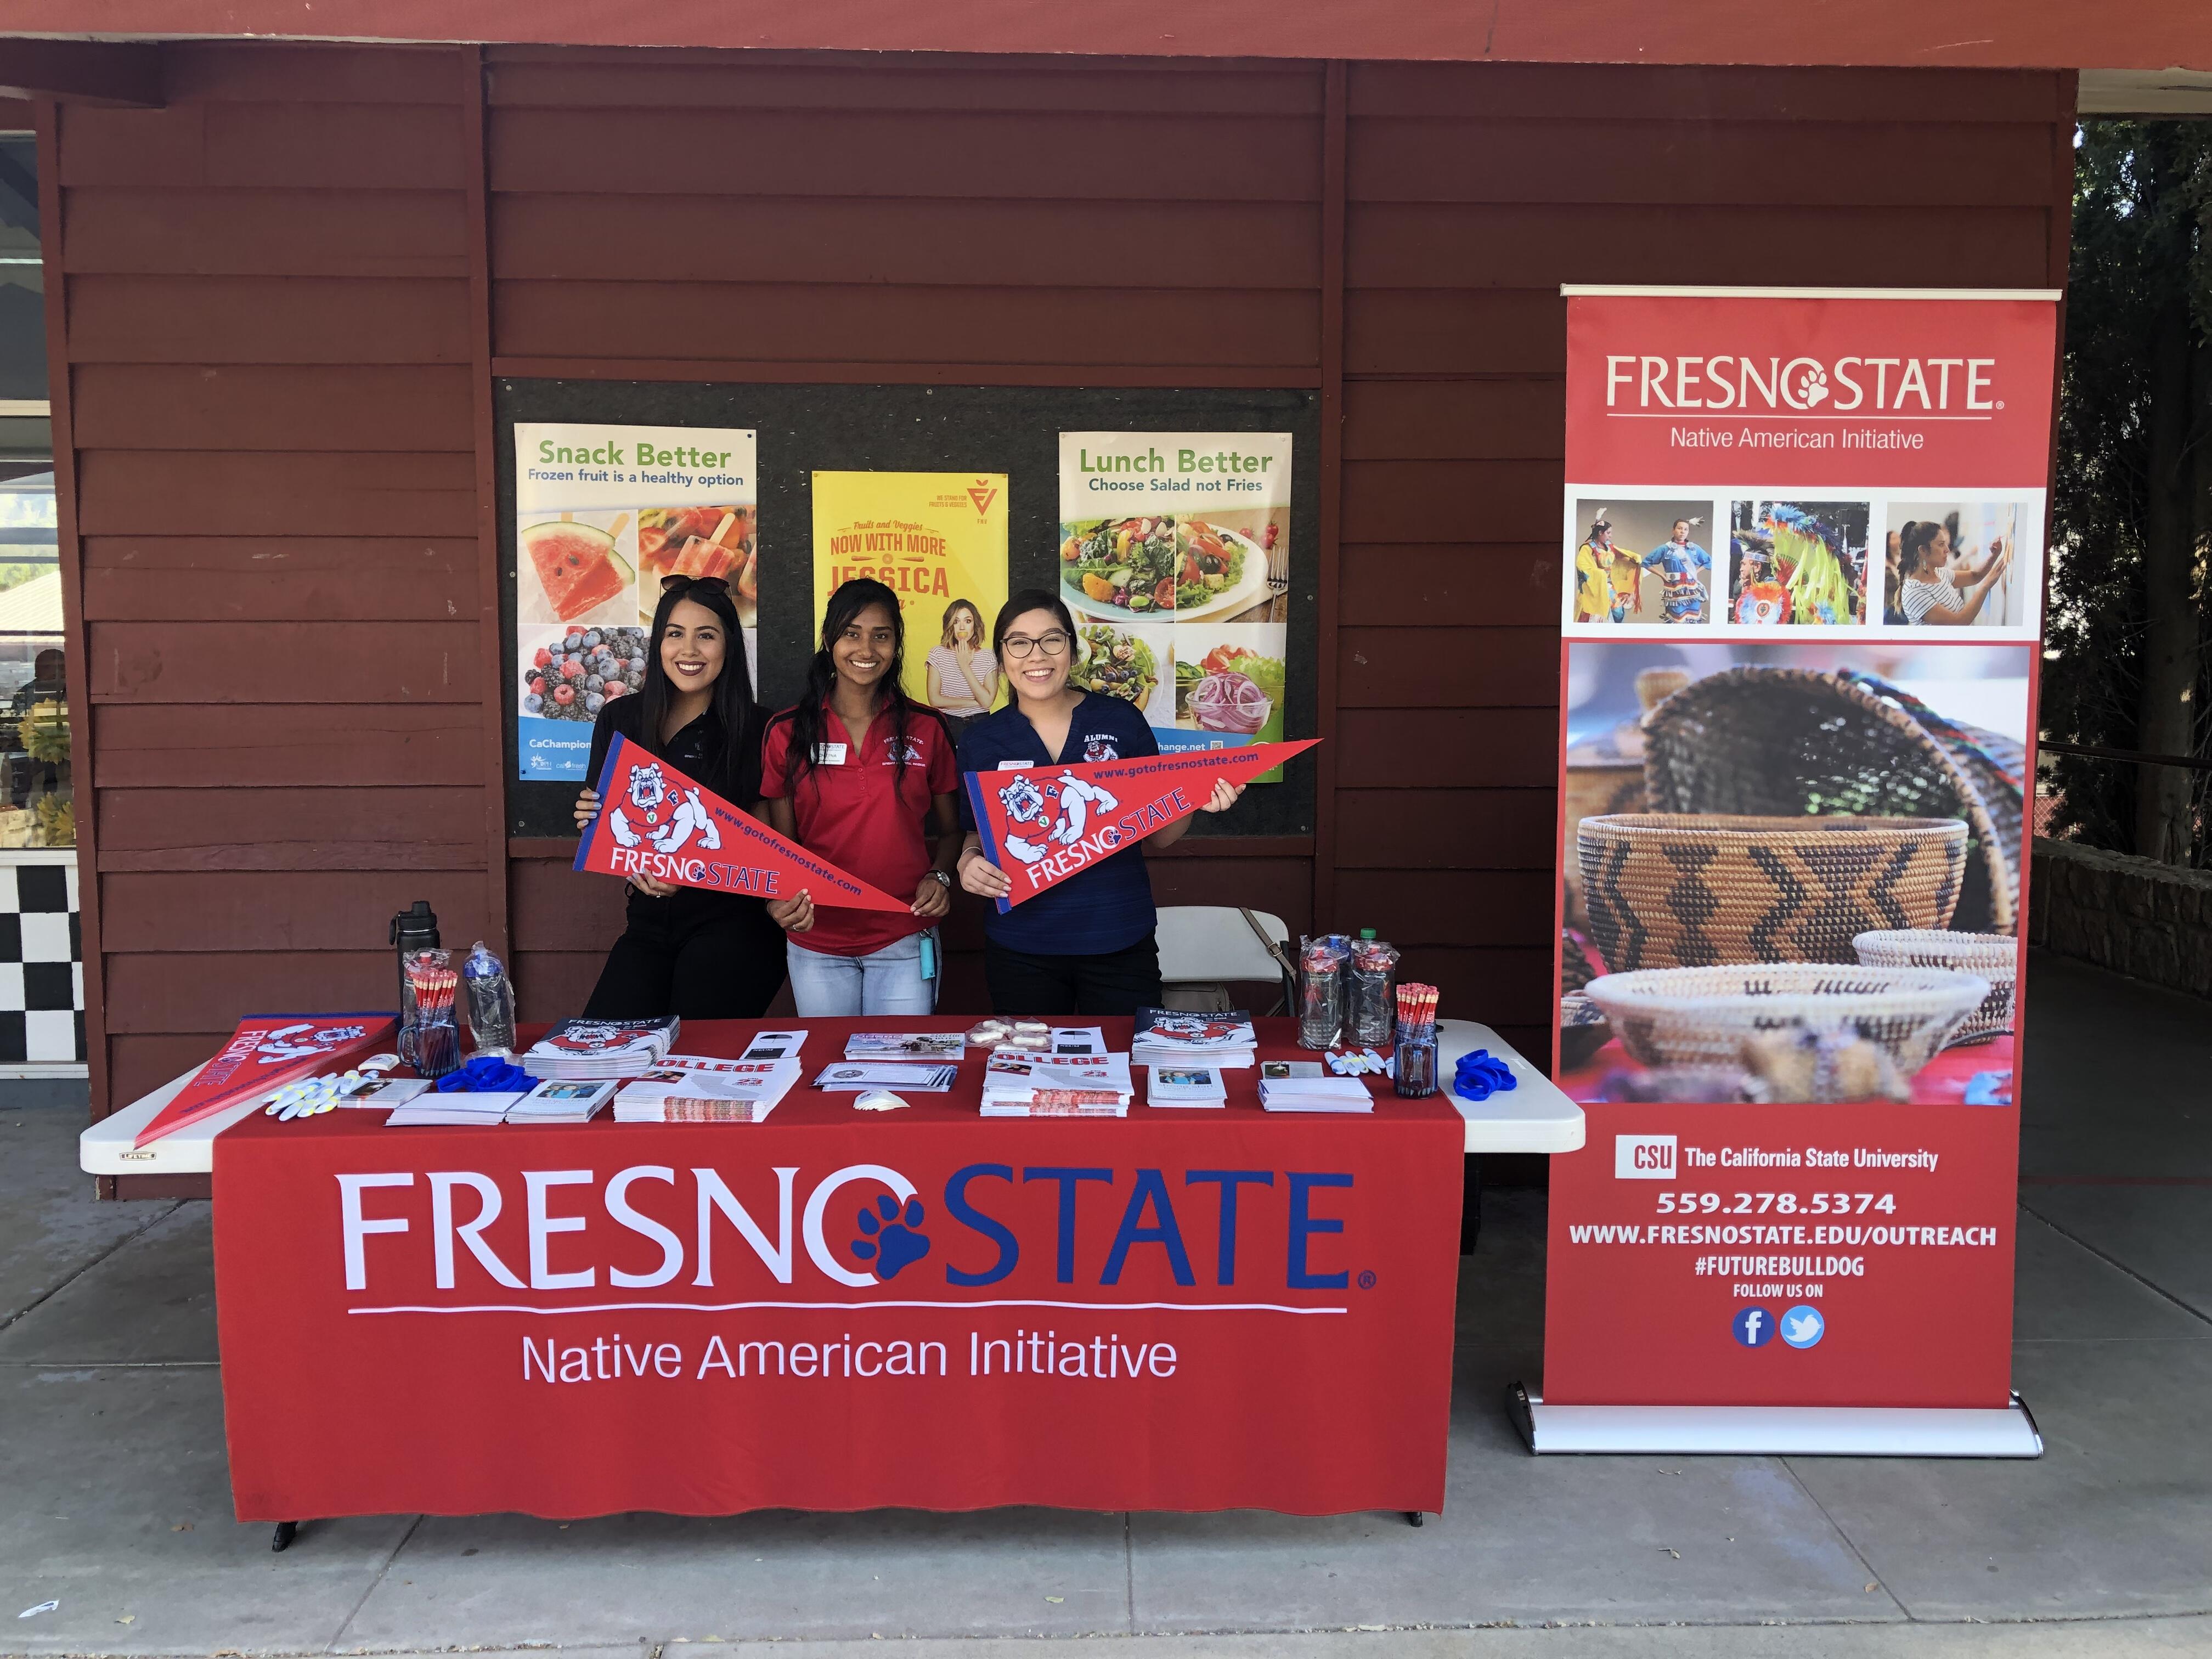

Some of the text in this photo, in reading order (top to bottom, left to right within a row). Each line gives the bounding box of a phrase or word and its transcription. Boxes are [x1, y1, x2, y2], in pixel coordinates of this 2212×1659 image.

[1606, 355, 1827, 410] FRESNO
[1671, 427, 1924, 449] Native American Initiative
[539, 439, 731, 469] Snack Better
[1080, 447, 1273, 473] Lunch Better
[528, 468, 744, 488] Frozen fruit is a healthy option
[1088, 477, 1262, 492] Choose Salad not Fries
[853, 520, 923, 533] Fruits and Veggies
[831, 533, 946, 557] NOW WITH MORE
[1084, 733, 1119, 743] ALUMNI
[1093, 752, 1260, 780] www.gotofresnostate.com
[1025, 787, 1191, 889] FRESNO STATE
[715, 807, 862, 896] www.gotofresnostate.com
[610, 847, 780, 894] FRESNO STATE
[623, 1018, 662, 1026] STATE
[1149, 1009, 1200, 1017] FRESNO
[217, 1029, 269, 1063] FRESNO
[1634, 1144, 1672, 1170] CSU
[1684, 1147, 1939, 1172] The California State University
[1656, 1192, 1897, 1215] 559.278.5374
[334, 1164, 919, 1290] FRESNO
[1568, 1224, 1997, 1246] WWW.FRESNOSTATE.EDU/OUTREACH
[1695, 1256, 1864, 1276] #FUTUREBULLDOG
[1733, 1283, 1824, 1298] FOLLOW US ON
[522, 1329, 1178, 1384] Native American Initiative
